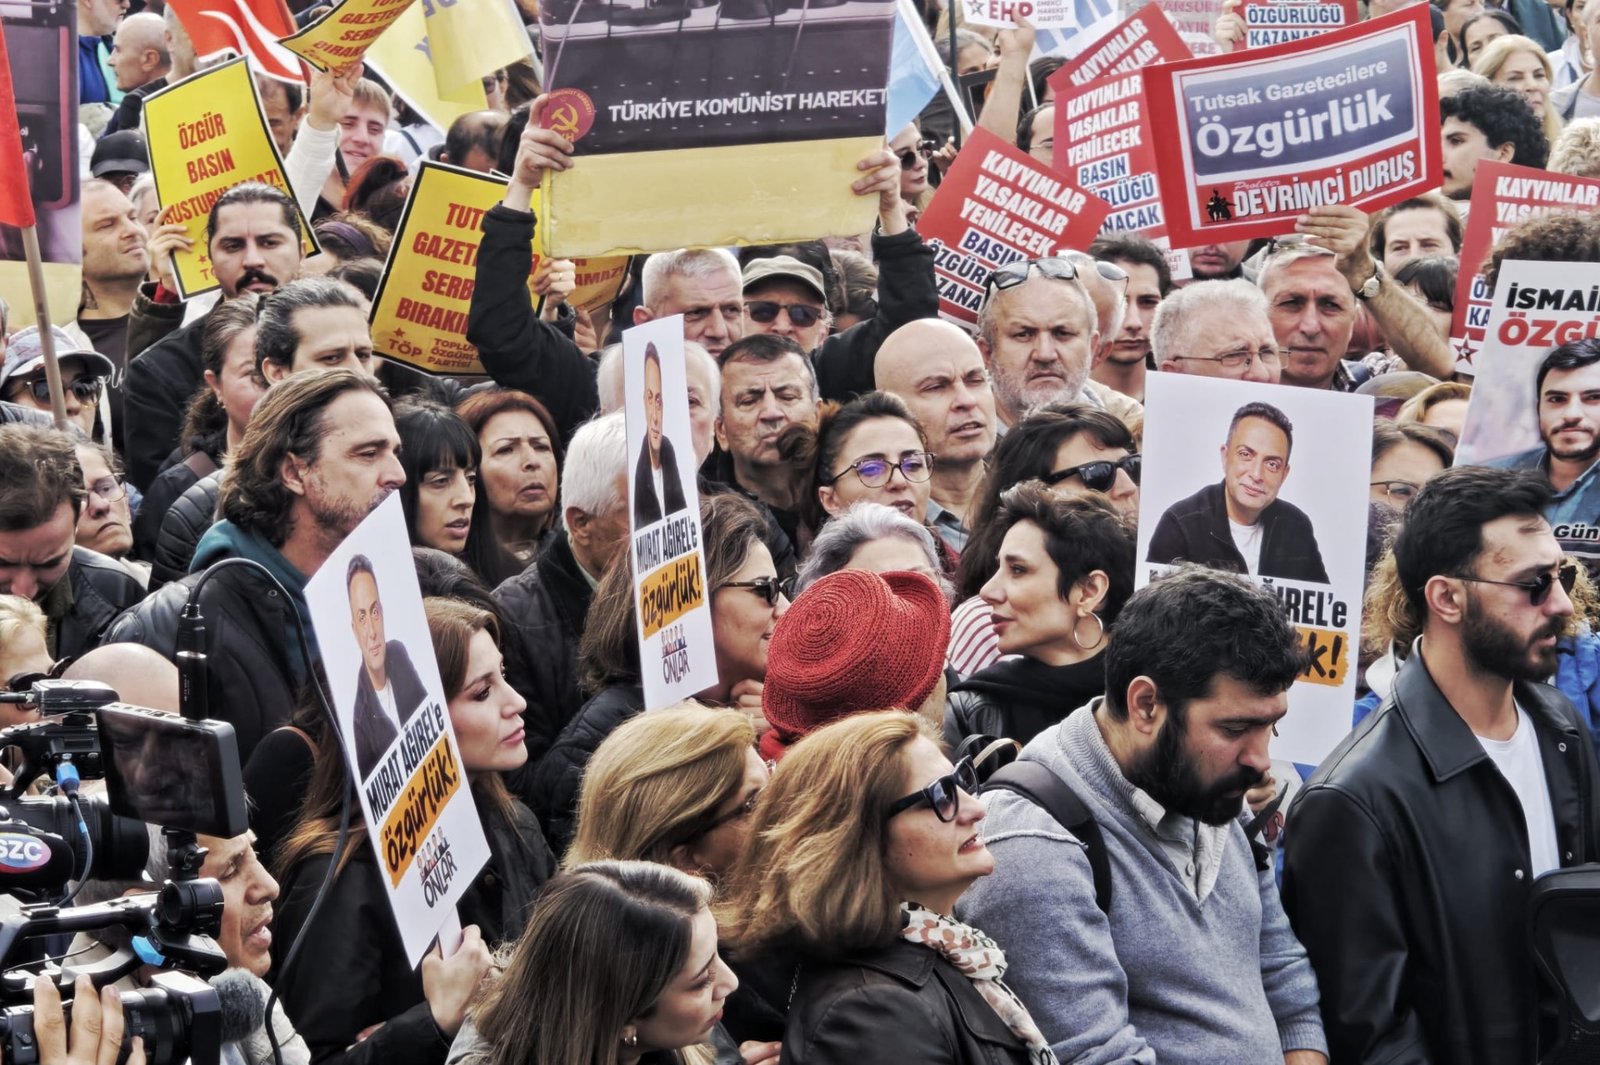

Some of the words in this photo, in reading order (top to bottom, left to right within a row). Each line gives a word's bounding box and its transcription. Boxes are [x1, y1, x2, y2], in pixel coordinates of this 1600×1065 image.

[1248, 5, 1341, 23] ÖZGÜRLÜĞÜ
[1070, 18, 1148, 86] KAYYIMLAR
[608, 97, 692, 122] TÜRKİYE
[695, 91, 796, 116] KOMÜNİST
[1067, 75, 1141, 120] KAYYIMLAR
[1190, 88, 1262, 112] Tutsak
[1266, 61, 1388, 101] Gazetecilere
[177, 112, 226, 150] ÖZGÜR
[1068, 101, 1139, 142] YASAKLAR
[1196, 88, 1394, 158] Özgürlük
[186, 148, 236, 184] BASIN
[1067, 125, 1142, 167] YENİLECEK
[980, 150, 1087, 214] KAYYIMLAR
[1080, 156, 1126, 186] BASIN
[1233, 168, 1345, 217] DEVRİMCİ
[1349, 151, 1416, 198] DURUŞ
[1495, 176, 1599, 206] KAYYIMLAR
[973, 174, 1068, 235] YASAKLAR
[1097, 205, 1161, 234] NACAK
[960, 197, 1057, 258] YENİLECEK
[421, 270, 476, 301] SERB
[1505, 282, 1600, 312] İSMAİ
[388, 338, 422, 357] TÖP
[635, 528, 662, 574] MURAT
[1553, 524, 1599, 539] Gün
[642, 556, 701, 628] özgürlük!
[662, 649, 690, 685] ONLAR
[366, 749, 405, 826] MURAT
[399, 702, 445, 775] AĞIREL'e
[385, 738, 458, 873] özgürlük!
[423, 850, 458, 909] ONLAR
